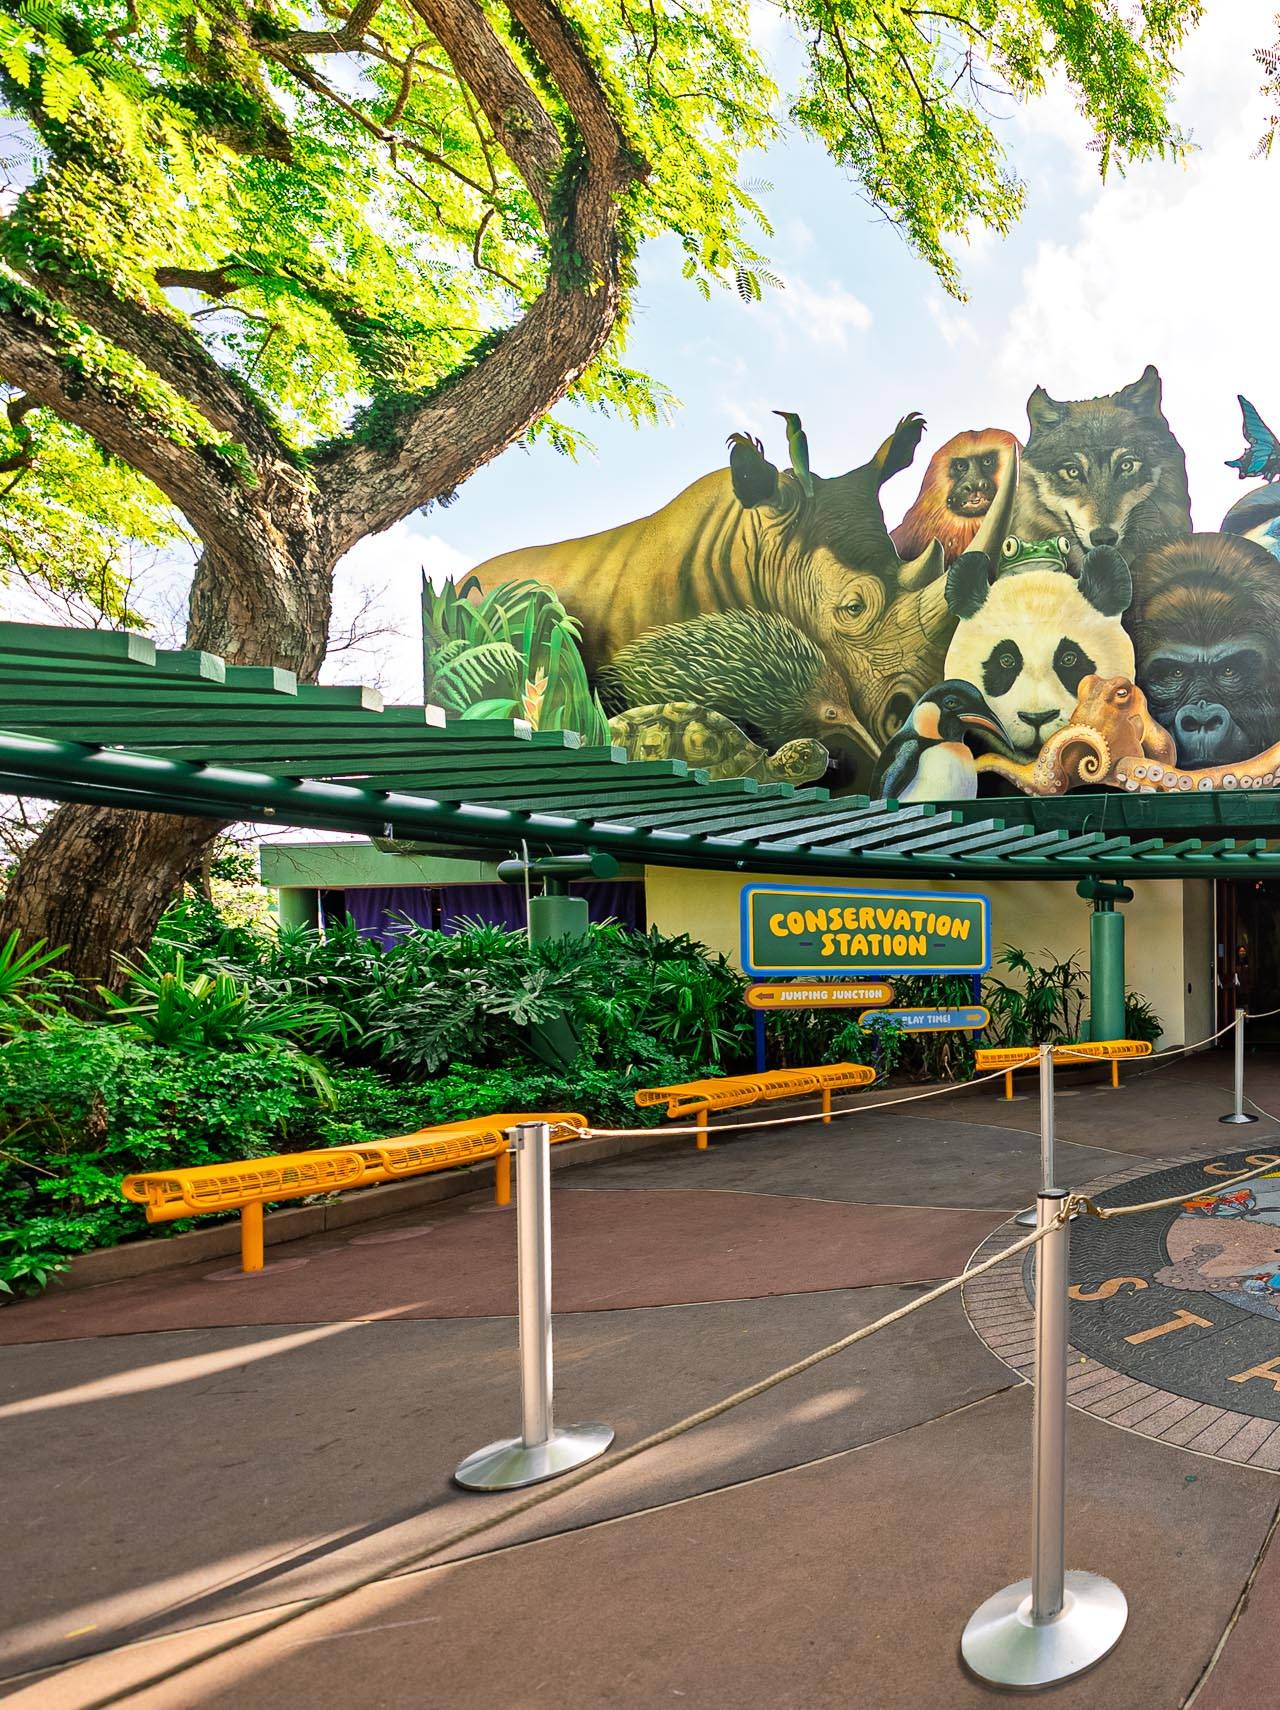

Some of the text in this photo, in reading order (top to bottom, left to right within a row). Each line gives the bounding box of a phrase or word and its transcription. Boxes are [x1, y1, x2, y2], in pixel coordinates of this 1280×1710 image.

[769, 907, 970, 940] CONSERVATION
[821, 934, 926, 956] STATION
[780, 990, 883, 1001] JUMPING JUNCTION
[927, 1014, 951, 1024] TIME!
